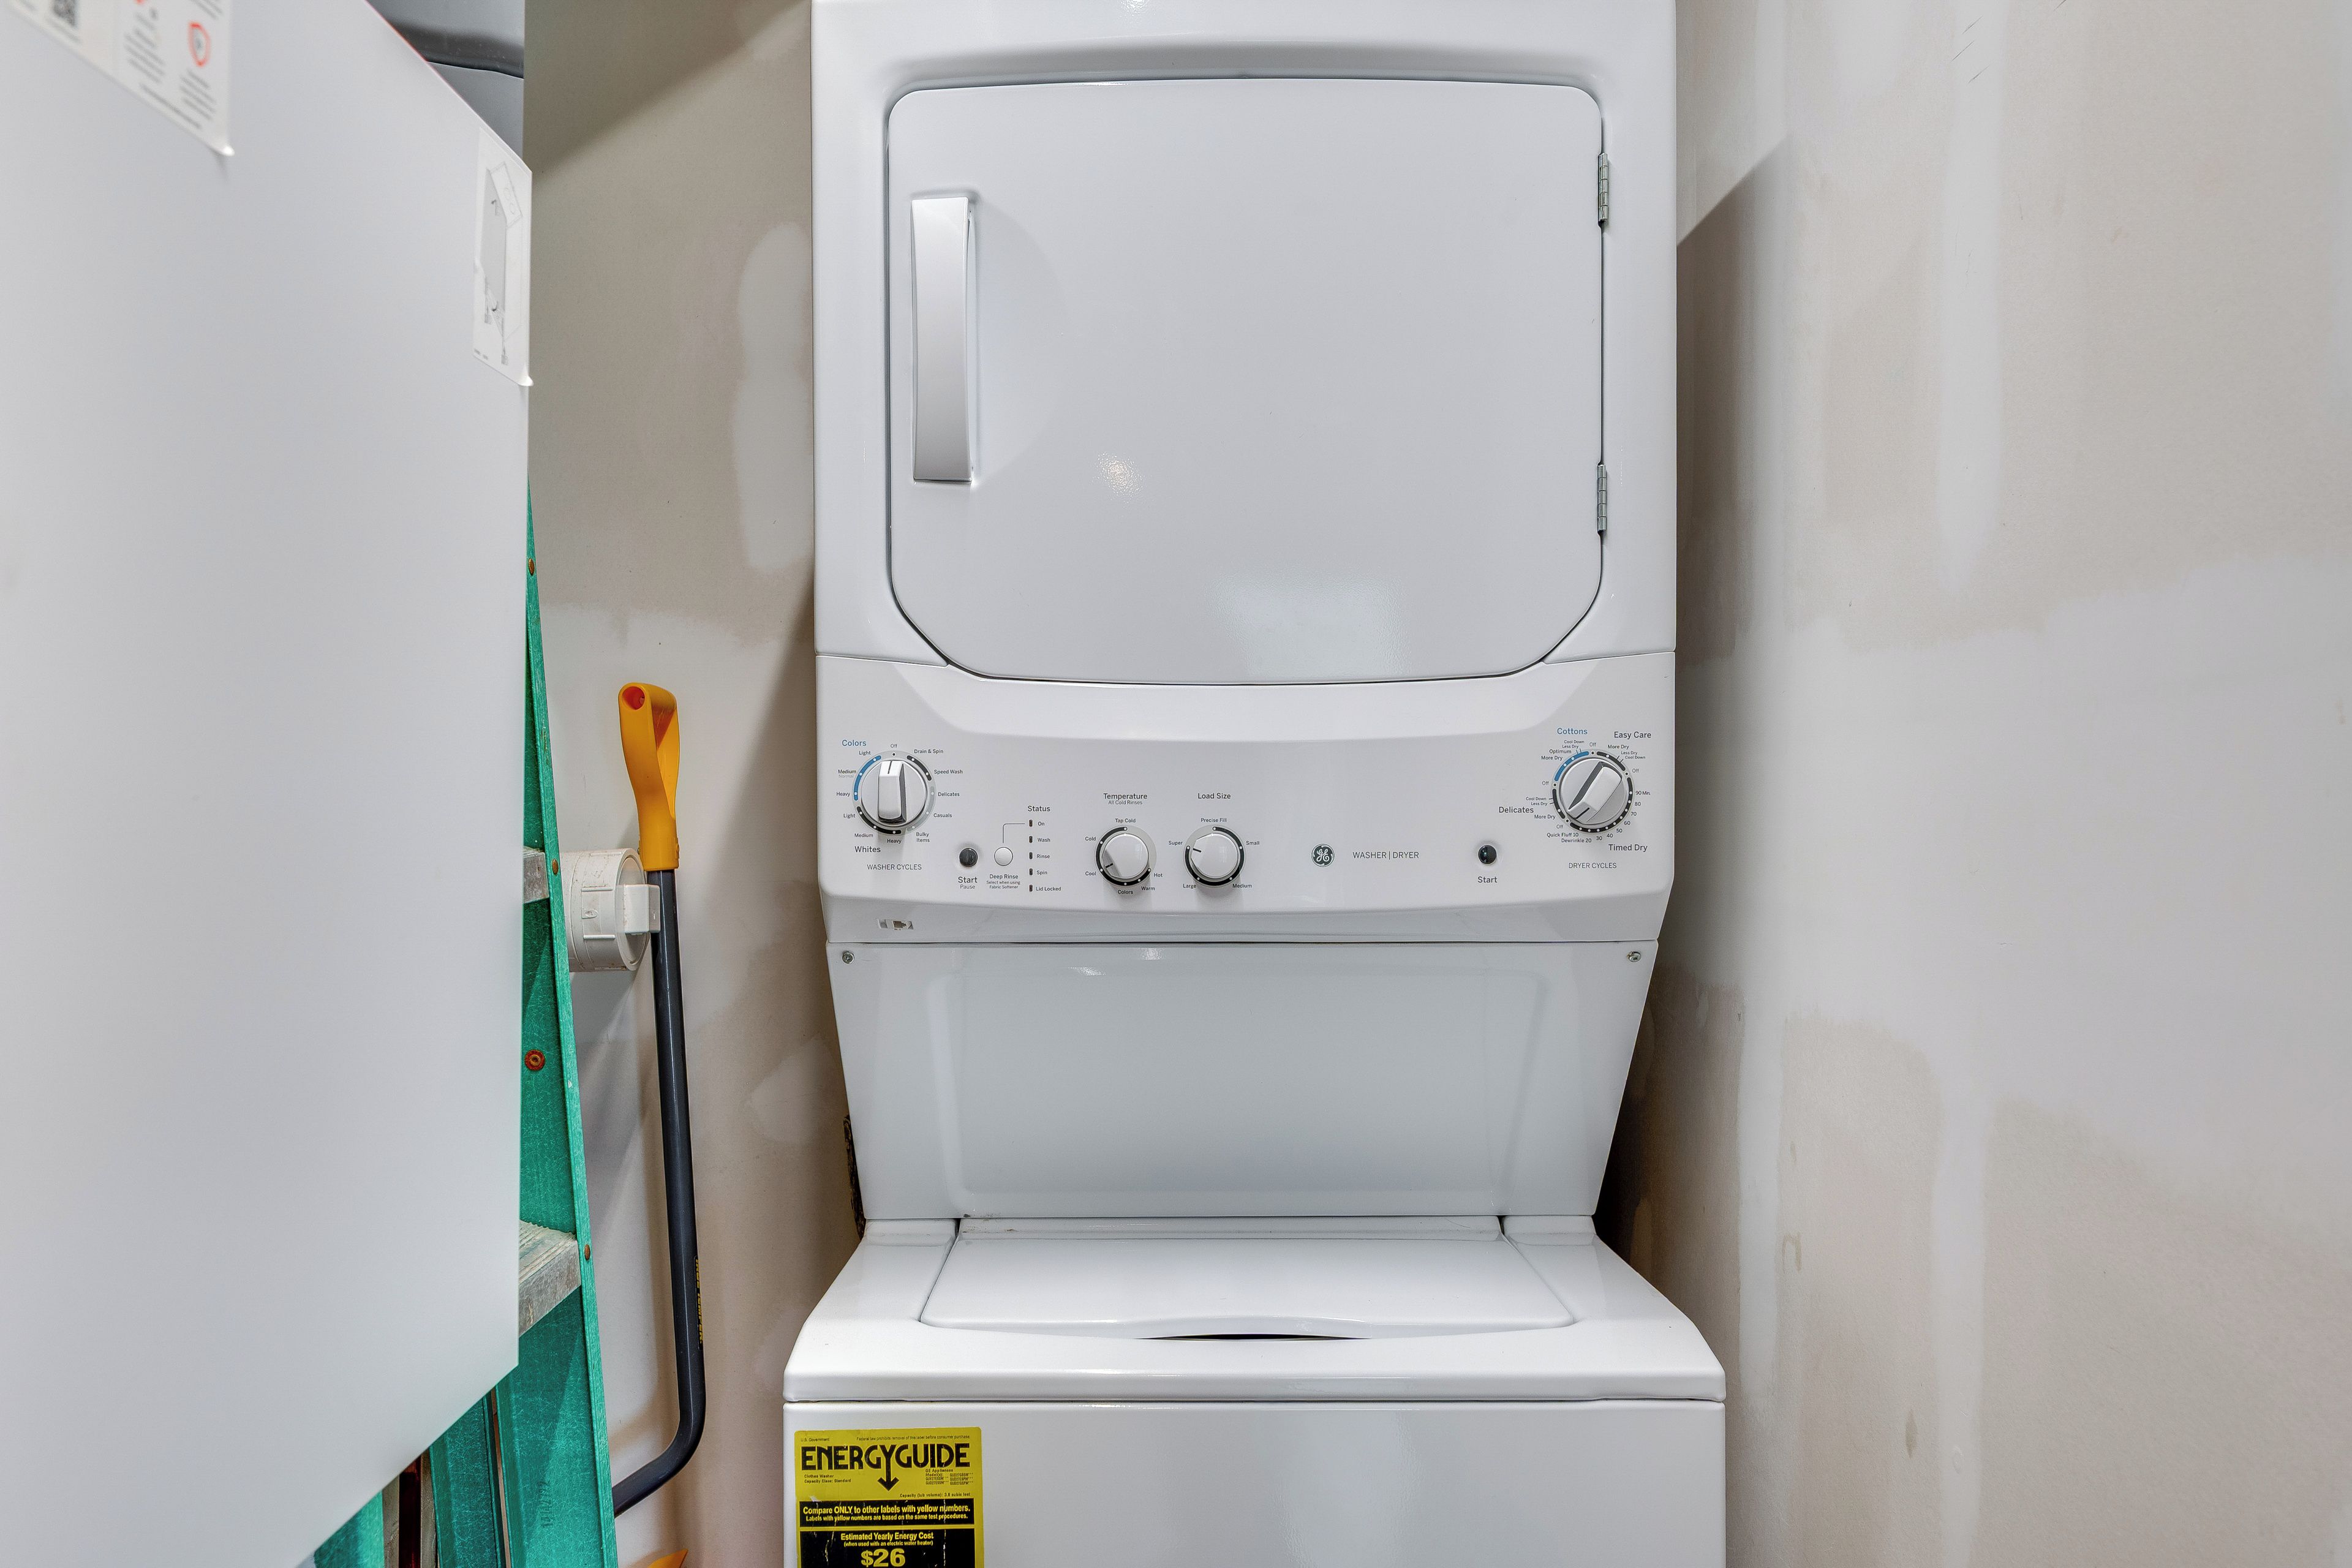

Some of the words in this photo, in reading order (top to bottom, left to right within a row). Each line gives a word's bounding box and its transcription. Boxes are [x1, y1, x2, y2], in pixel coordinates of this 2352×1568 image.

[1634, 844, 1648, 853] Dry
[801, 1443, 970, 1491] ENERGYGUIDE
[834, 1506, 852, 1514] ONLY
[917, 1504, 937, 1513] yellow
[895, 1532, 917, 1541] Energy
[861, 1548, 905, 1567] $26
